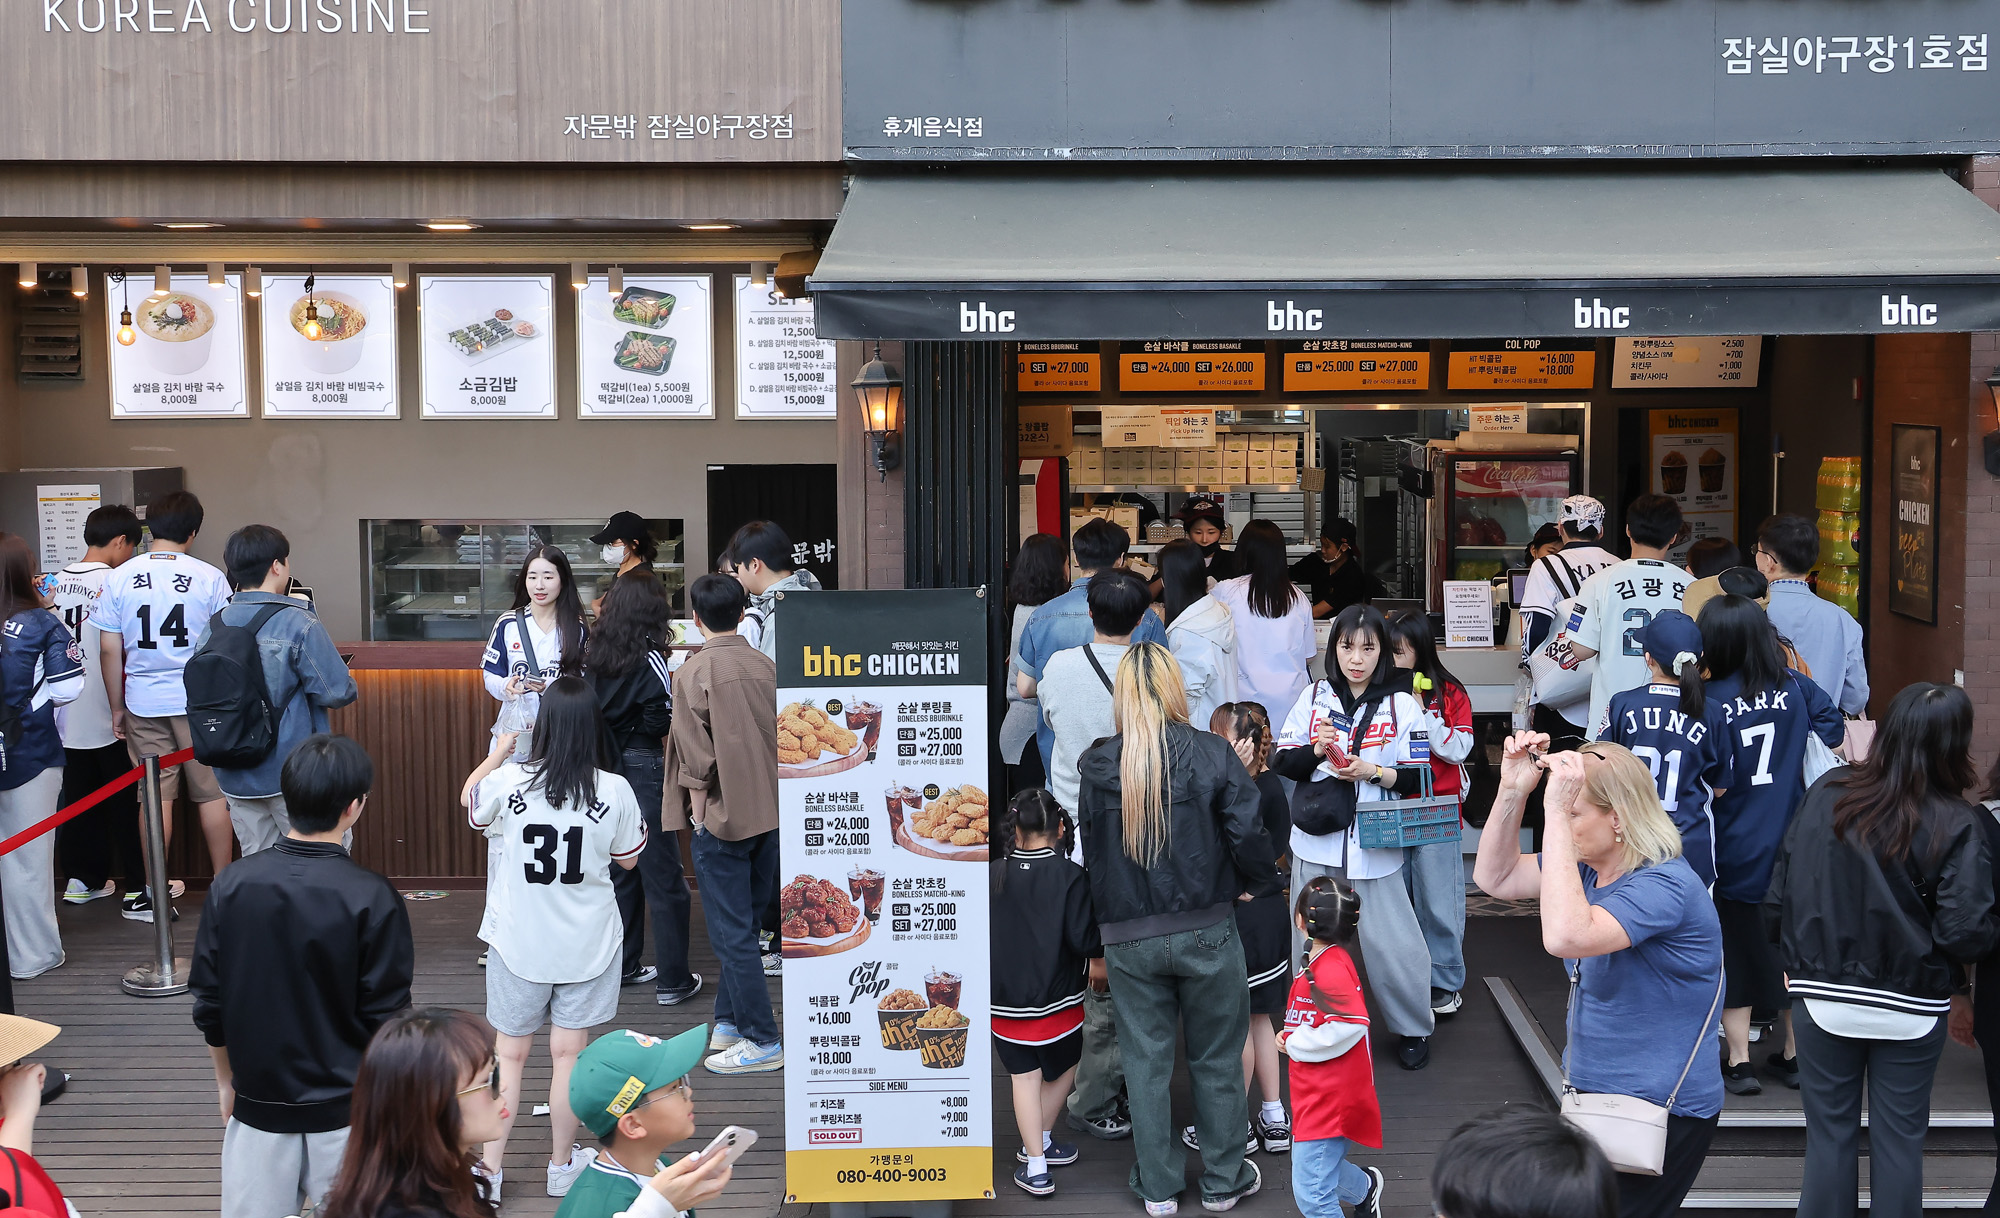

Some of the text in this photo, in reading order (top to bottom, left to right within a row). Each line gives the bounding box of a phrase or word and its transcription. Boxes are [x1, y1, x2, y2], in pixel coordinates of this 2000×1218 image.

[44, 0, 431, 33] KOREA CUISINE
[1721, 33, 1989, 75] 잠실야구장1호점
[563, 113, 795, 140] 자문밖 잠실야구장점
[882, 116, 984, 138] 휴게음식점
[1266, 300, 1324, 332] bhc
[1574, 298, 1630, 329] bhc
[1881, 295, 1938, 325] bhc
[960, 301, 1016, 333] bhc
[782, 327, 815, 337] 12,500
[1144, 341, 1161, 351] 순살
[1302, 341, 1320, 351] 순살
[1322, 340, 1348, 351] 맛초킹
[1505, 339, 1541, 349] COL POP
[783, 350, 825, 360] 12,500원
[1540, 353, 1575, 364] ₩16,000
[1032, 361, 1089, 374] SET ₩27,000
[1151, 361, 1190, 374] ₩24,000
[1197, 363, 1211, 372] SET
[1215, 361, 1254, 373] ₩26,000
[1315, 361, 1354, 372] ₩25,000
[1361, 361, 1375, 371] SET
[1379, 360, 1418, 372] ₩27,000
[1539, 365, 1574, 375] ₩18,000
[783, 372, 825, 383] 15,000원
[132, 382, 225, 392] 살얼음 김치 바람 국수
[274, 381, 385, 392] 살얼음 김치 바람 비빔국수
[459, 377, 518, 392] 소금김밥
[600, 382, 691, 393] 떡갈비(1ea) 5,500원
[161, 394, 198, 405] 8,000원
[312, 393, 348, 404] 8,000원
[470, 395, 507, 406] 8,000원
[598, 394, 694, 404] 떡갈비(2ea) 1,0000원
[784, 395, 825, 406] 15,000원
[1183, 417, 1198, 426] 하는
[1200, 417, 1209, 426] 곳
[1477, 414, 1520, 424] 주문 하는 곳
[1668, 415, 1687, 428] bhc
[1911, 456, 1921, 470] bhc
[1899, 500, 1930, 526] CHICKEN
[136, 604, 189, 650] 14
[921, 641, 943, 650] 맛있는
[944, 641, 959, 650] 치킨
[803, 645, 960, 677] bhc CHICKEN
[827, 703, 842, 712] BEST
[897, 701, 952, 714] 순살 뿌링클
[897, 714, 963, 723] BONELESS BBURINKLE
[1625, 707, 1708, 746] JUNG
[899, 727, 962, 741] 단품 ₩25,000
[899, 743, 962, 757] SET ₩27,000
[1740, 721, 1777, 787] 7
[920, 758, 938, 766] 사이다
[939, 757, 964, 766] 음료포함)
[804, 791, 860, 804] 순살 바삭클
[924, 787, 939, 797] BEST
[805, 803, 864, 813] BONELESS BASAKLE
[806, 817, 869, 831] 단품 ₩24,000
[807, 833, 870, 846] SET ₩26,000
[522, 823, 585, 886] 31
[892, 877, 946, 890] 순살 맛초킹
[892, 890, 966, 899] BONELESS MATCHO-KING
[894, 903, 956, 916] 단품 ₩25,000
[894, 919, 957, 932] SET ₩27,000
[849, 961, 882, 986] Col
[849, 979, 890, 1004] pop
[809, 996, 840, 1008] 빅콜팝
[809, 1011, 851, 1026] ₩16,000
[809, 1034, 861, 1047] 뿌링빅콜팝
[809, 1051, 852, 1065] ₩18,000
[869, 1081, 908, 1091] SIDE MENU
[820, 1099, 846, 1110] 치즈볼
[941, 1097, 968, 1107] ₩8,000
[820, 1114, 862, 1125] 뿌링치즈볼
[941, 1112, 968, 1123] ₩9,000
[813, 1131, 857, 1140] SOLD OUT
[941, 1127, 968, 1138] ₩7,000
[870, 1154, 914, 1166] 가맹문의
[836, 1168, 947, 1184] 080-400-9003
